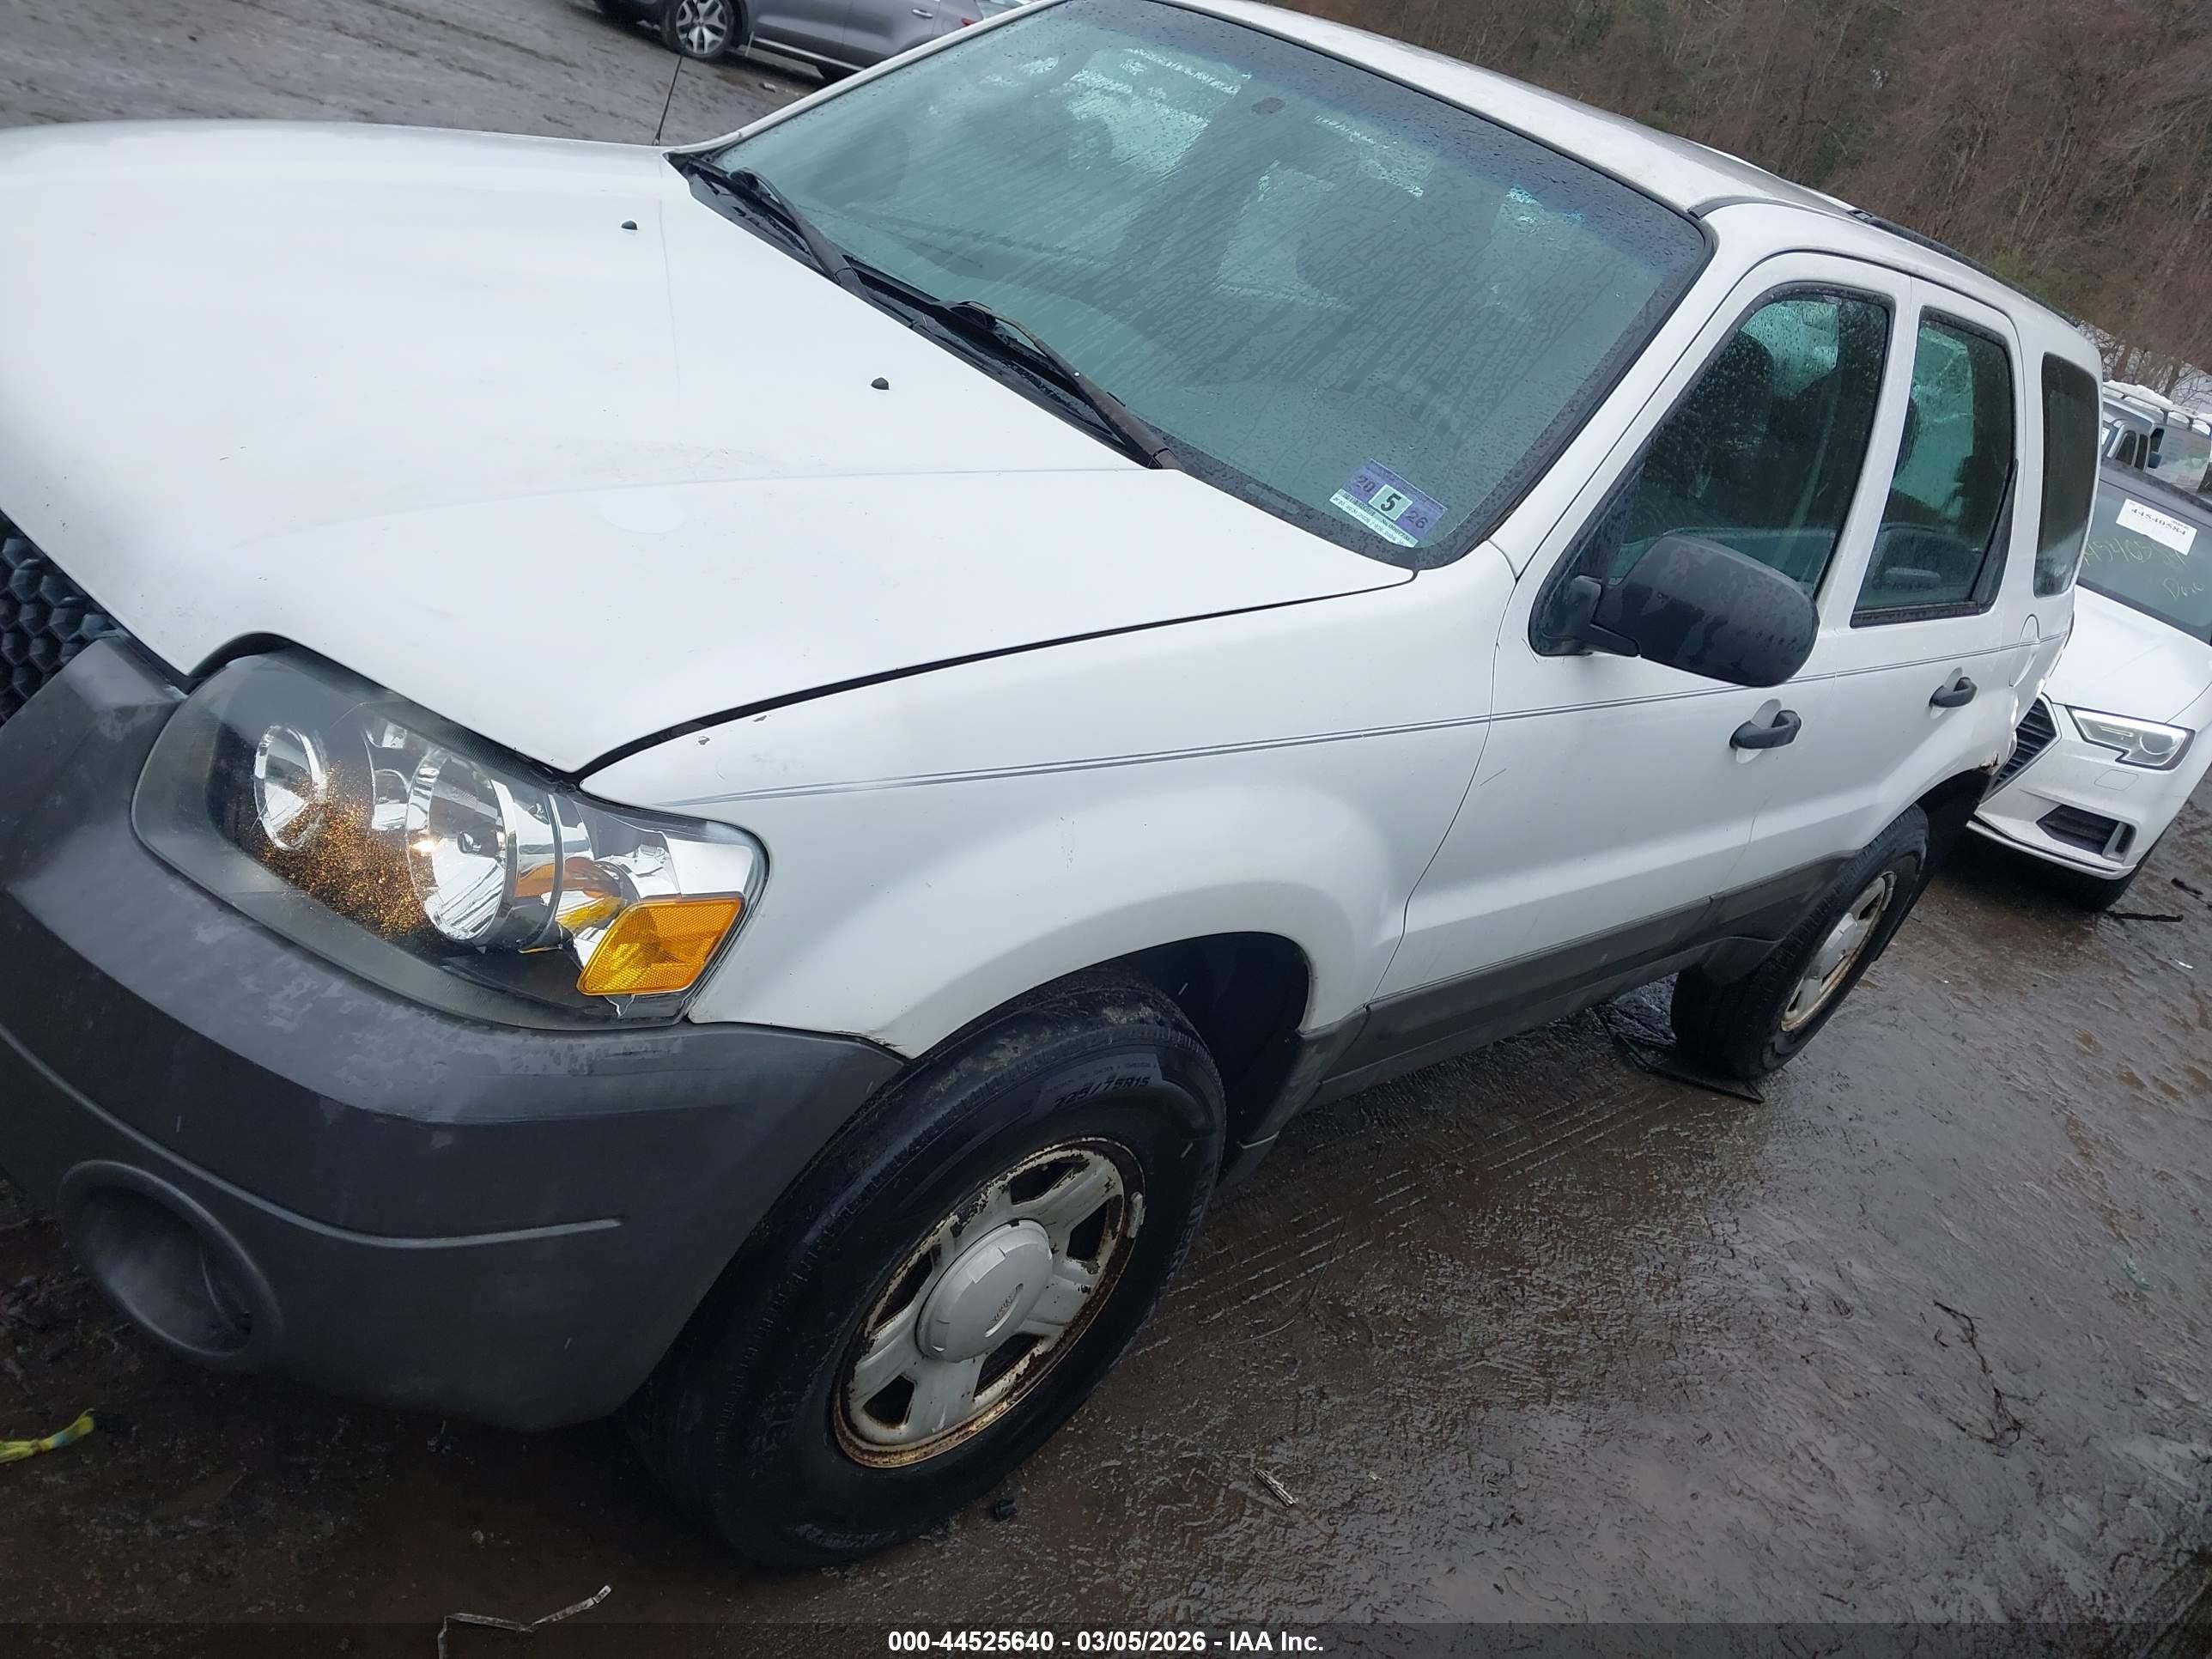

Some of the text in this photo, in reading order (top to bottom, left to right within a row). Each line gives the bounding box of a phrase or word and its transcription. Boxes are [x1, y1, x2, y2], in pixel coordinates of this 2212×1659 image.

[1380, 493, 1402, 512] 5
[1406, 509, 1429, 530] 26
[2130, 508, 2186, 535] 44540584
